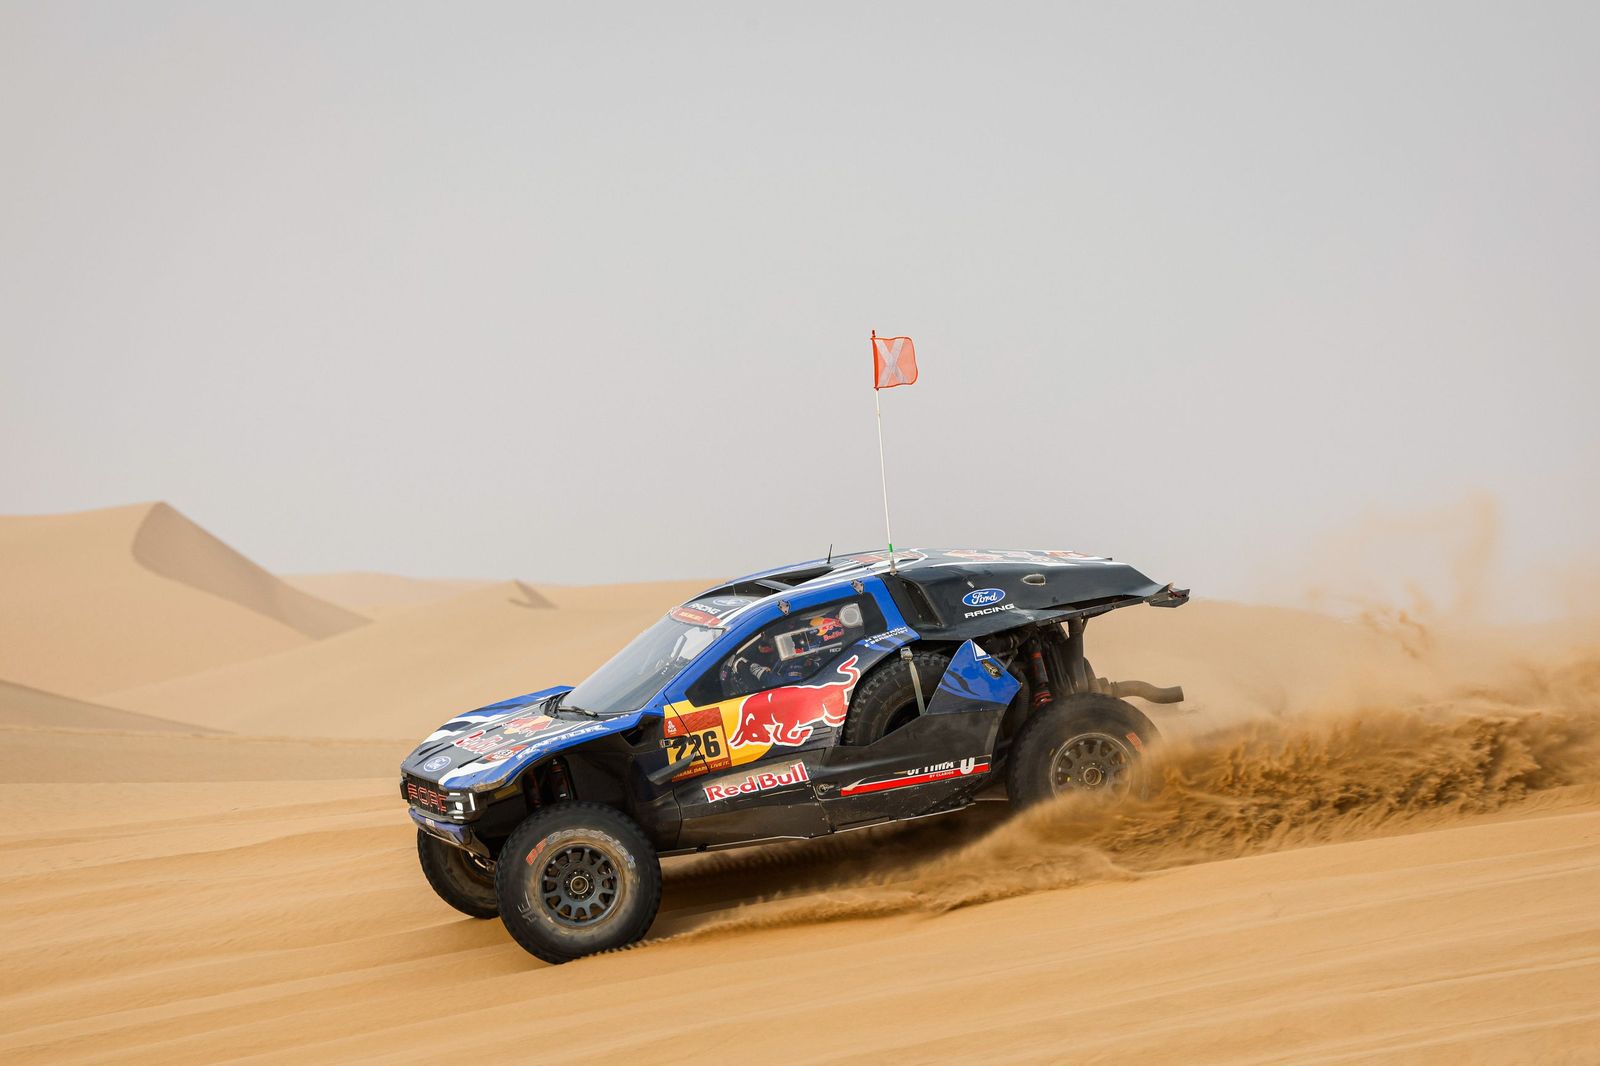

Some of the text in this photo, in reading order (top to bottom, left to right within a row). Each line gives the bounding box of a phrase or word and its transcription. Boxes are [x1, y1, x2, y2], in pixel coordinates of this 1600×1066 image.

[964, 603, 1015, 619] RACING
[673, 730, 721, 762] 226
[704, 761, 809, 803] Red Bull
